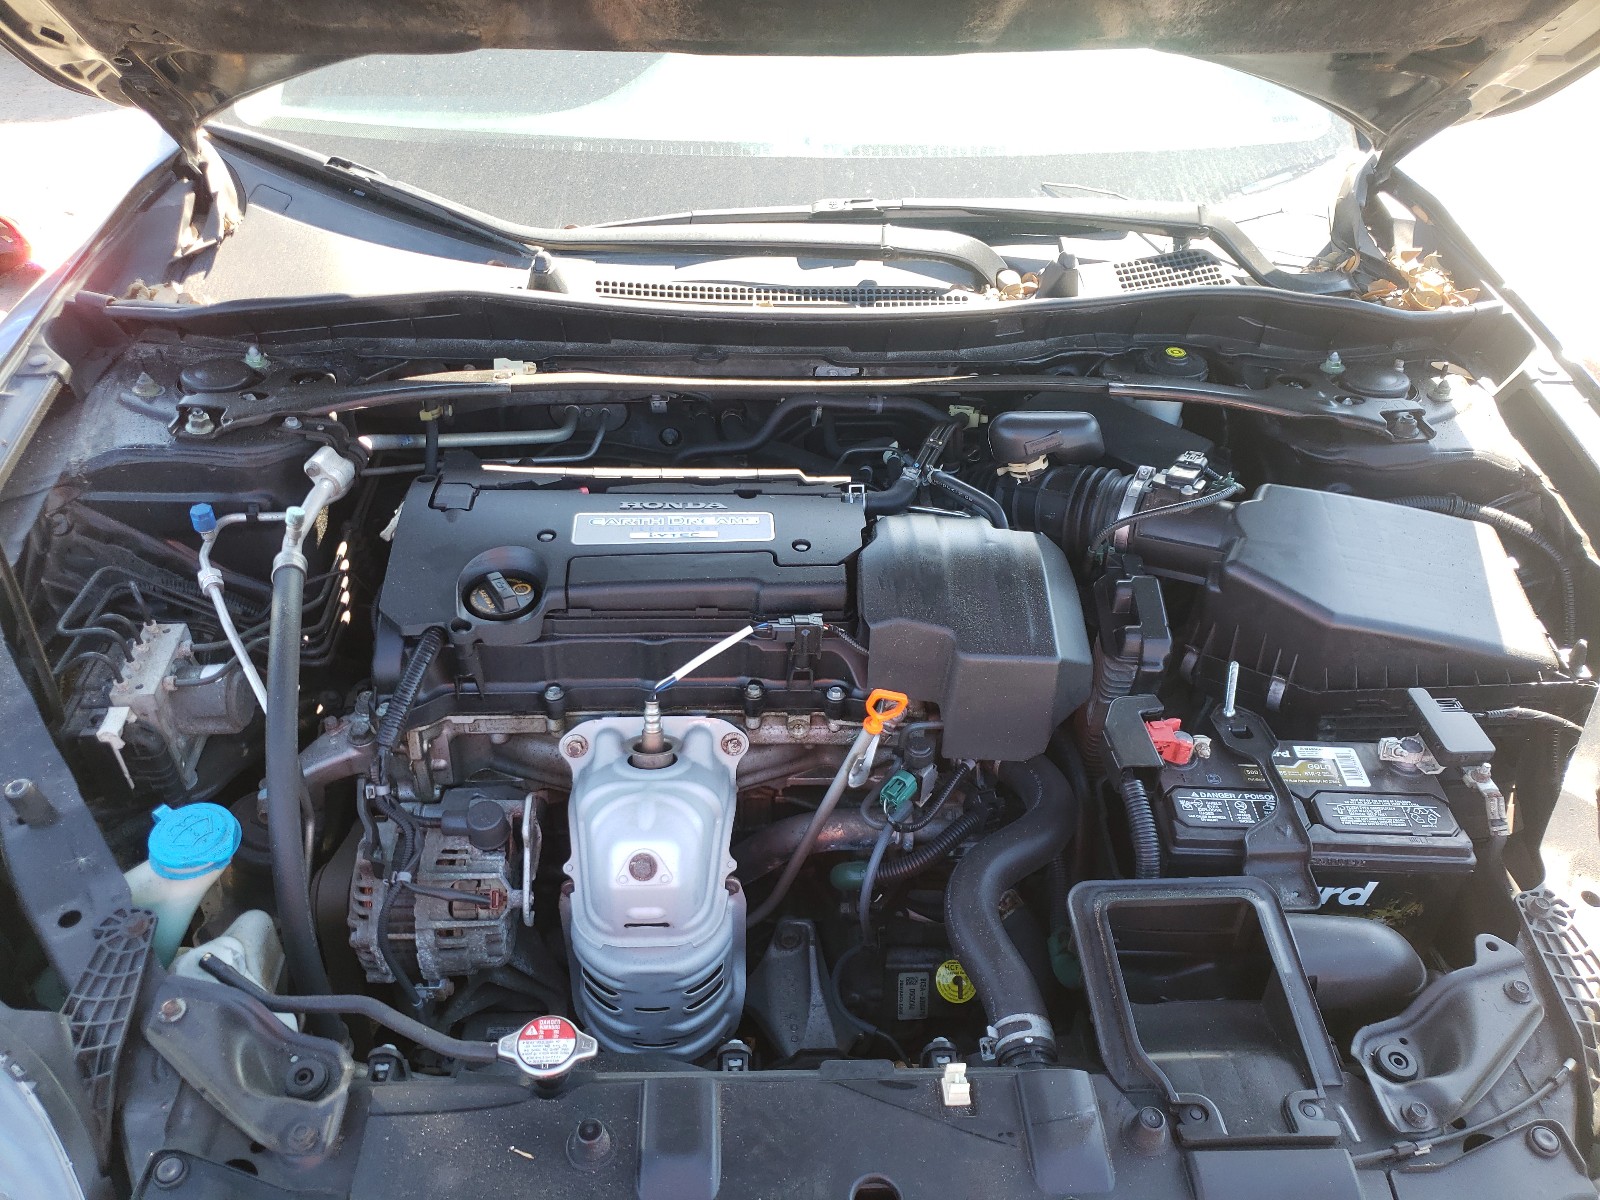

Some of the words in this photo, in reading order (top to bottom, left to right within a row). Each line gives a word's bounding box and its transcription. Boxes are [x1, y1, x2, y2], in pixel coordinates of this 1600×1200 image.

[620, 502, 728, 511] HONDA
[1199, 791, 1236, 799] DANGER
[1316, 881, 1380, 906] rd
